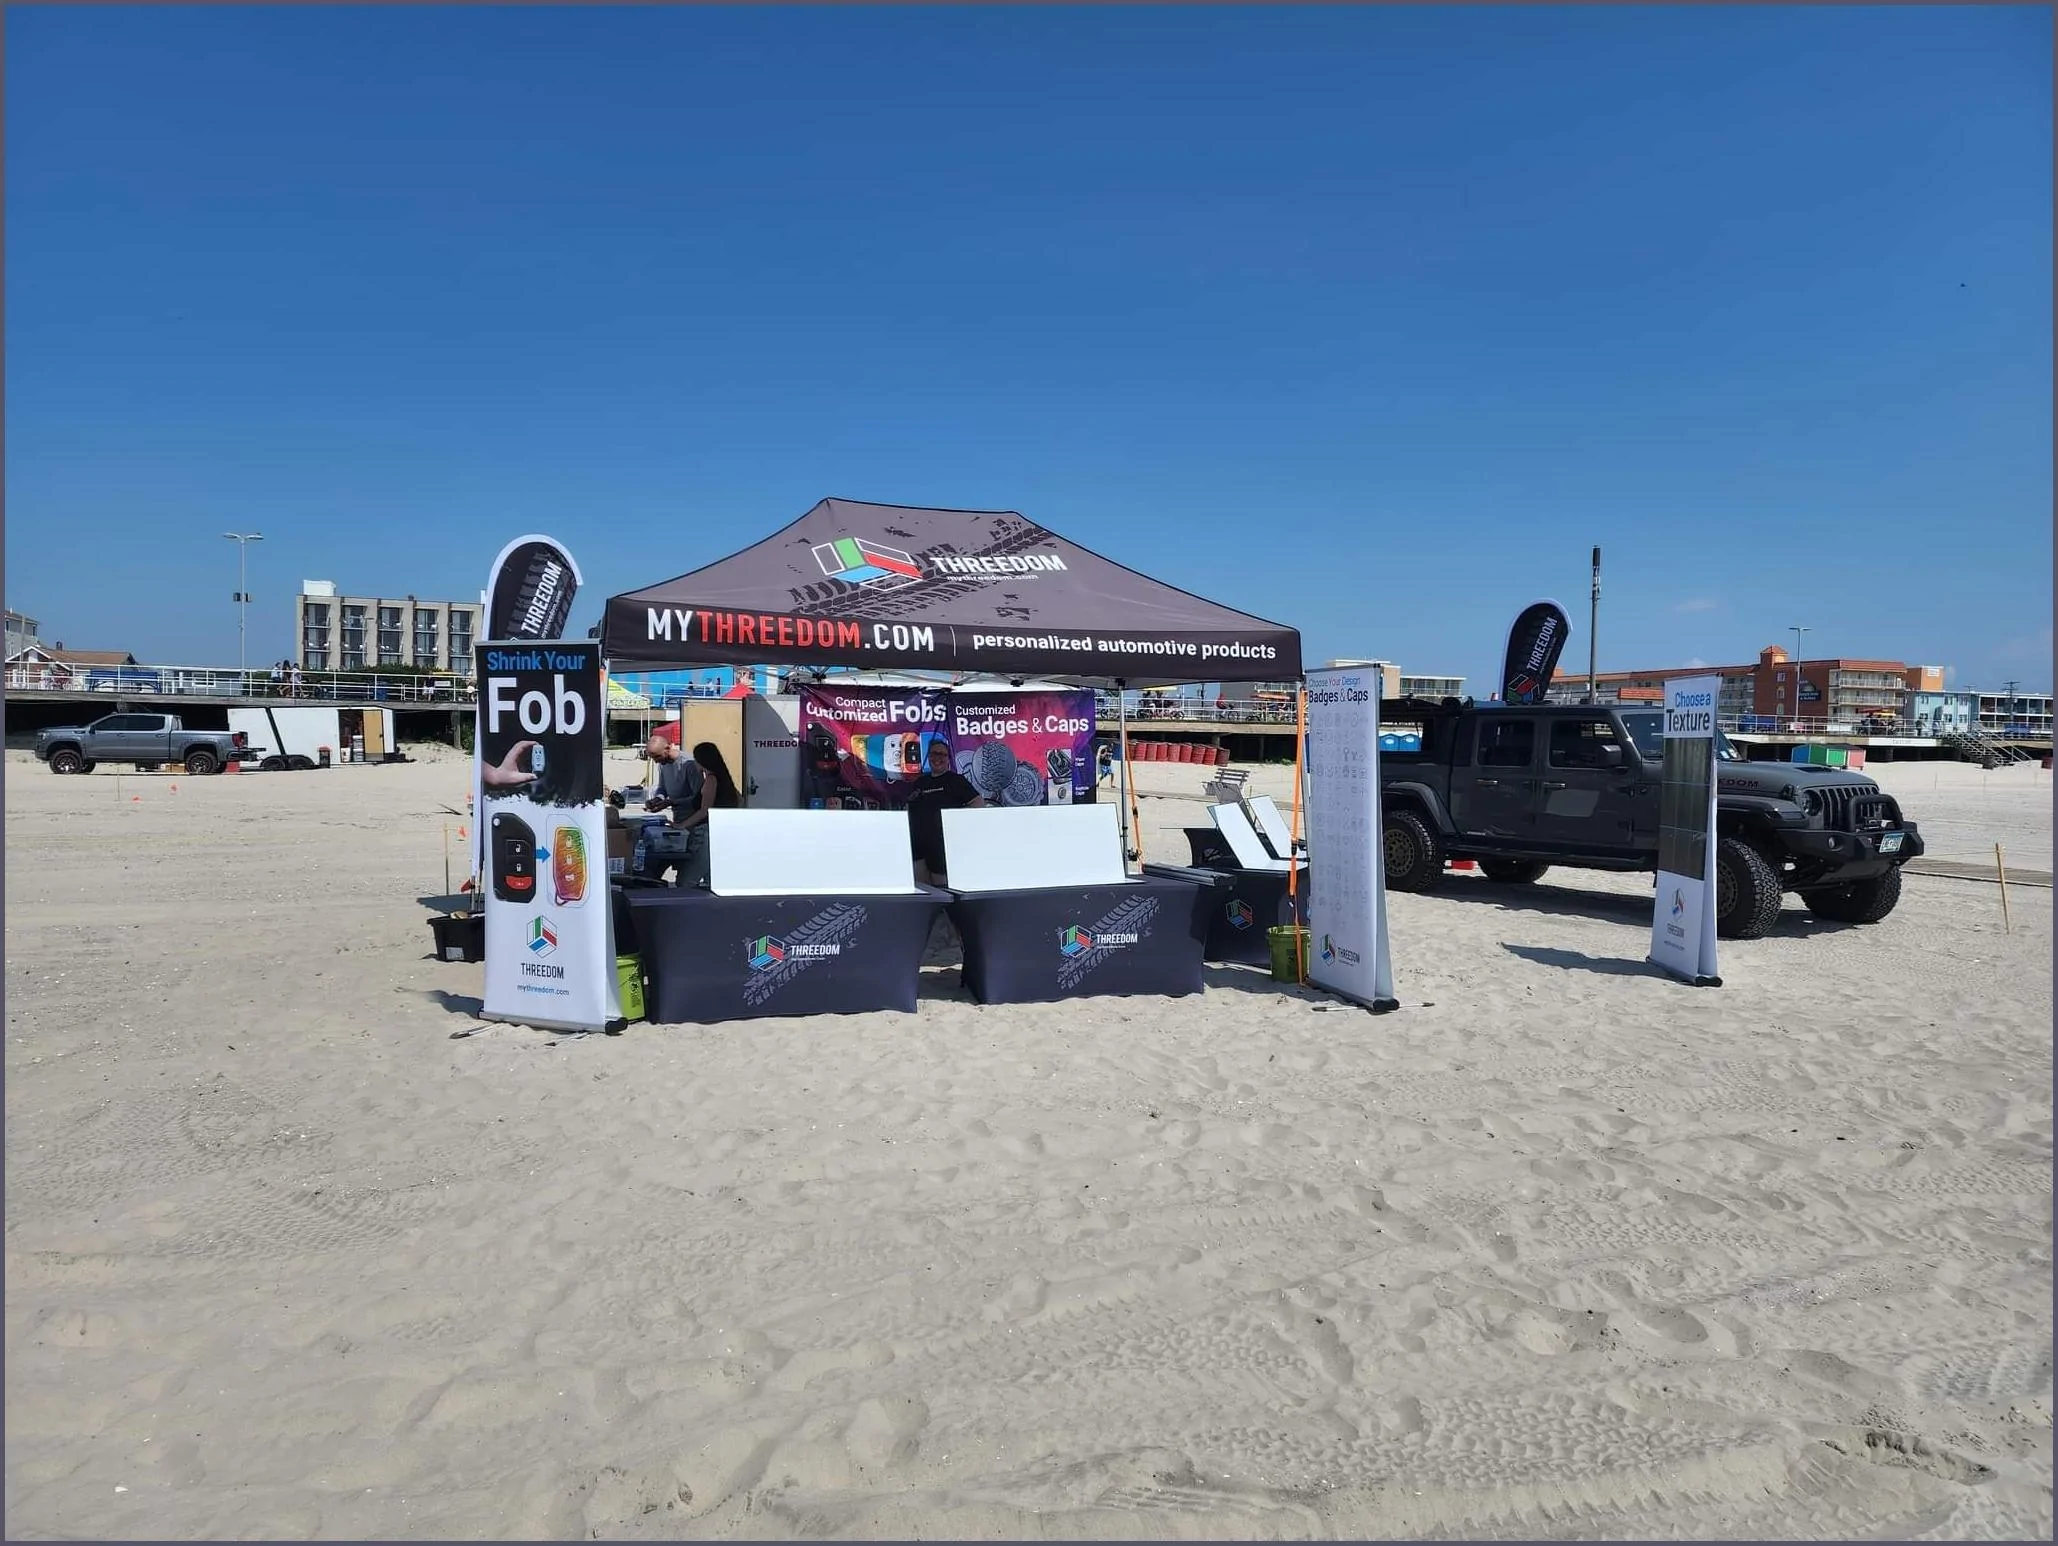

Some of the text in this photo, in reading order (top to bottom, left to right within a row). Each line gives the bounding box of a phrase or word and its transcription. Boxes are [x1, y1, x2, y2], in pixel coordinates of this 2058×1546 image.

[930, 555, 1067, 573] THREEDOM
[521, 560, 563, 635] THREEDOM
[973, 634, 1276, 660] personalized automotive products
[1527, 616, 1558, 671] THREEDOM
[487, 651, 585, 670] Shrink Your
[488, 674, 586, 735] Fob
[835, 696, 886, 710] Compact
[1309, 689, 1339, 706] Badges
[1347, 687, 1368, 706] Caps
[1675, 691, 1705, 708] Choose
[806, 700, 947, 723] Customized Fobs
[955, 704, 1016, 716] Customized
[957, 715, 1090, 740] Badges & Caps
[1666, 708, 1710, 732] Texture
[1096, 933, 1138, 944] THREEDOM
[790, 944, 840, 956] THREEDOM
[521, 963, 565, 980] THREEDOM
[517, 984, 570, 996] mythreedom.com
